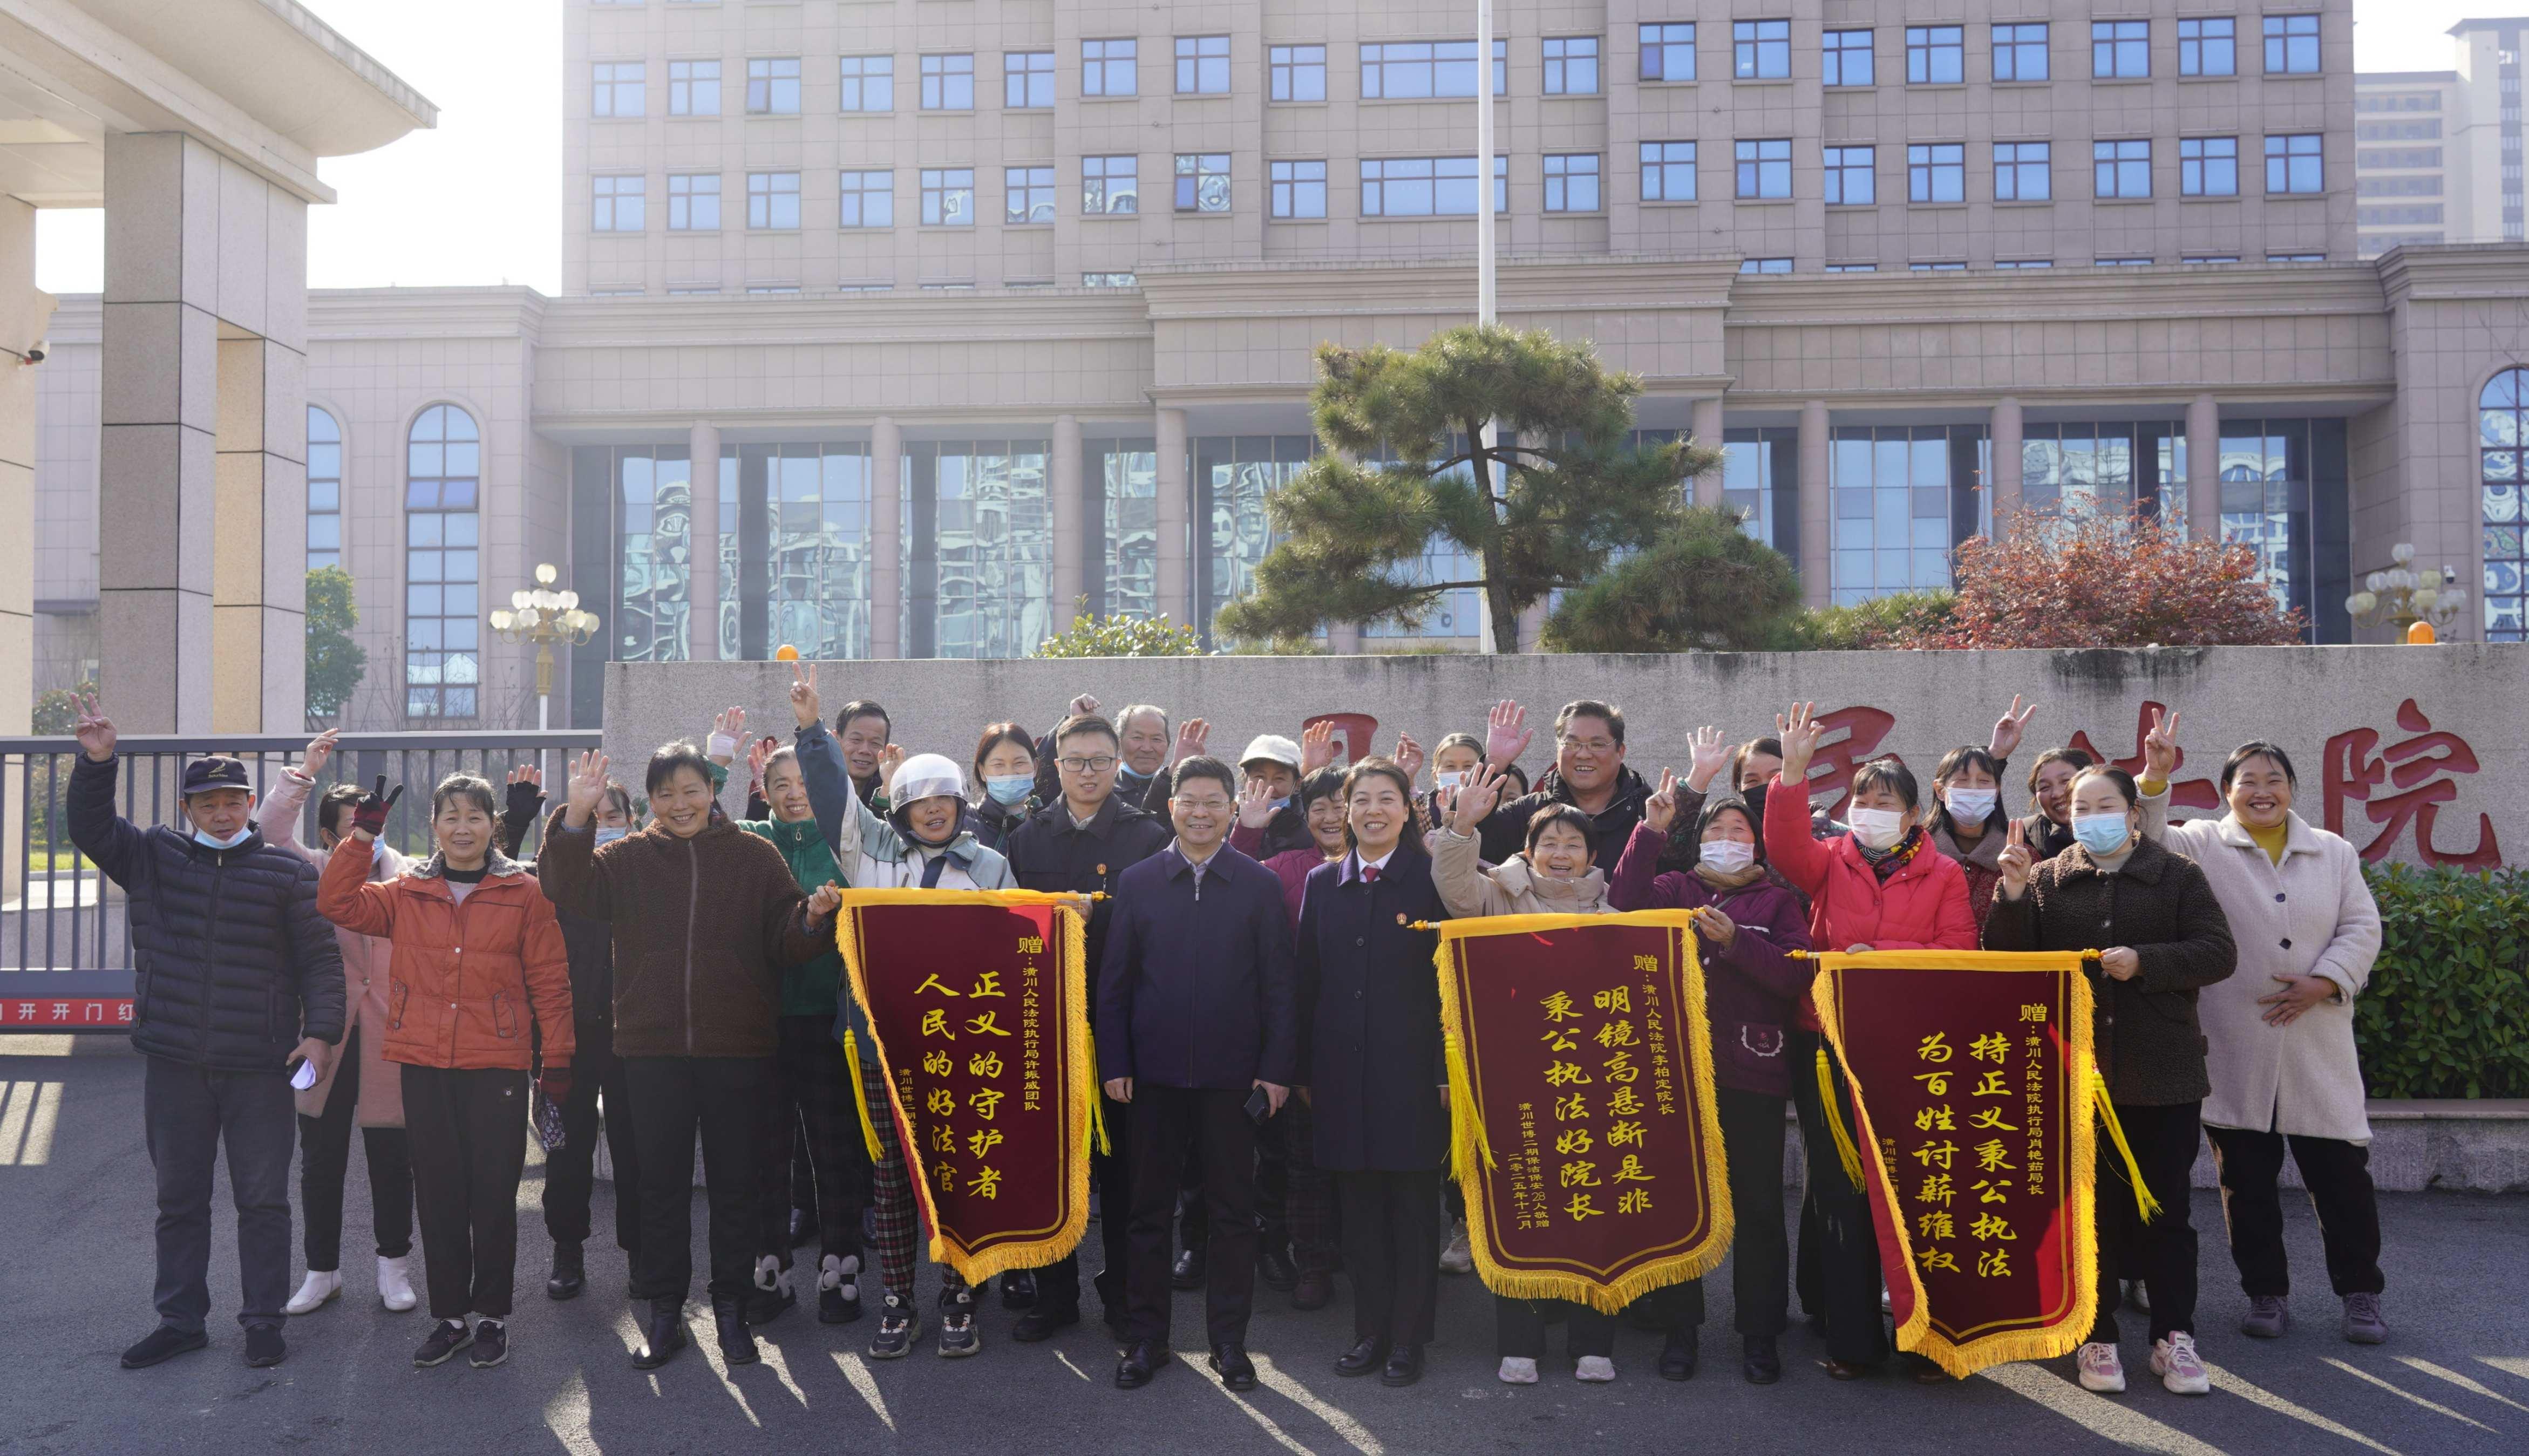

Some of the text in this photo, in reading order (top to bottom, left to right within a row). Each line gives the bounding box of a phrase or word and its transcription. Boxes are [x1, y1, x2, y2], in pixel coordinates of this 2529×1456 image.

[0, 1003, 134, 1021] 开开门红
[914, 974, 961, 1192] 人民的好法官
[965, 971, 1011, 1200] 正义的守护者
[1540, 991, 1605, 1221] 秉公执法好院长
[1593, 985, 1655, 1214] 明镜高悬断是非
[1508, 1153, 1532, 1230] 二零二五年十二月
[1912, 1031, 1961, 1273] 为百姓讨薪维权
[1968, 1032, 2018, 1278] 持正义秉公执法
